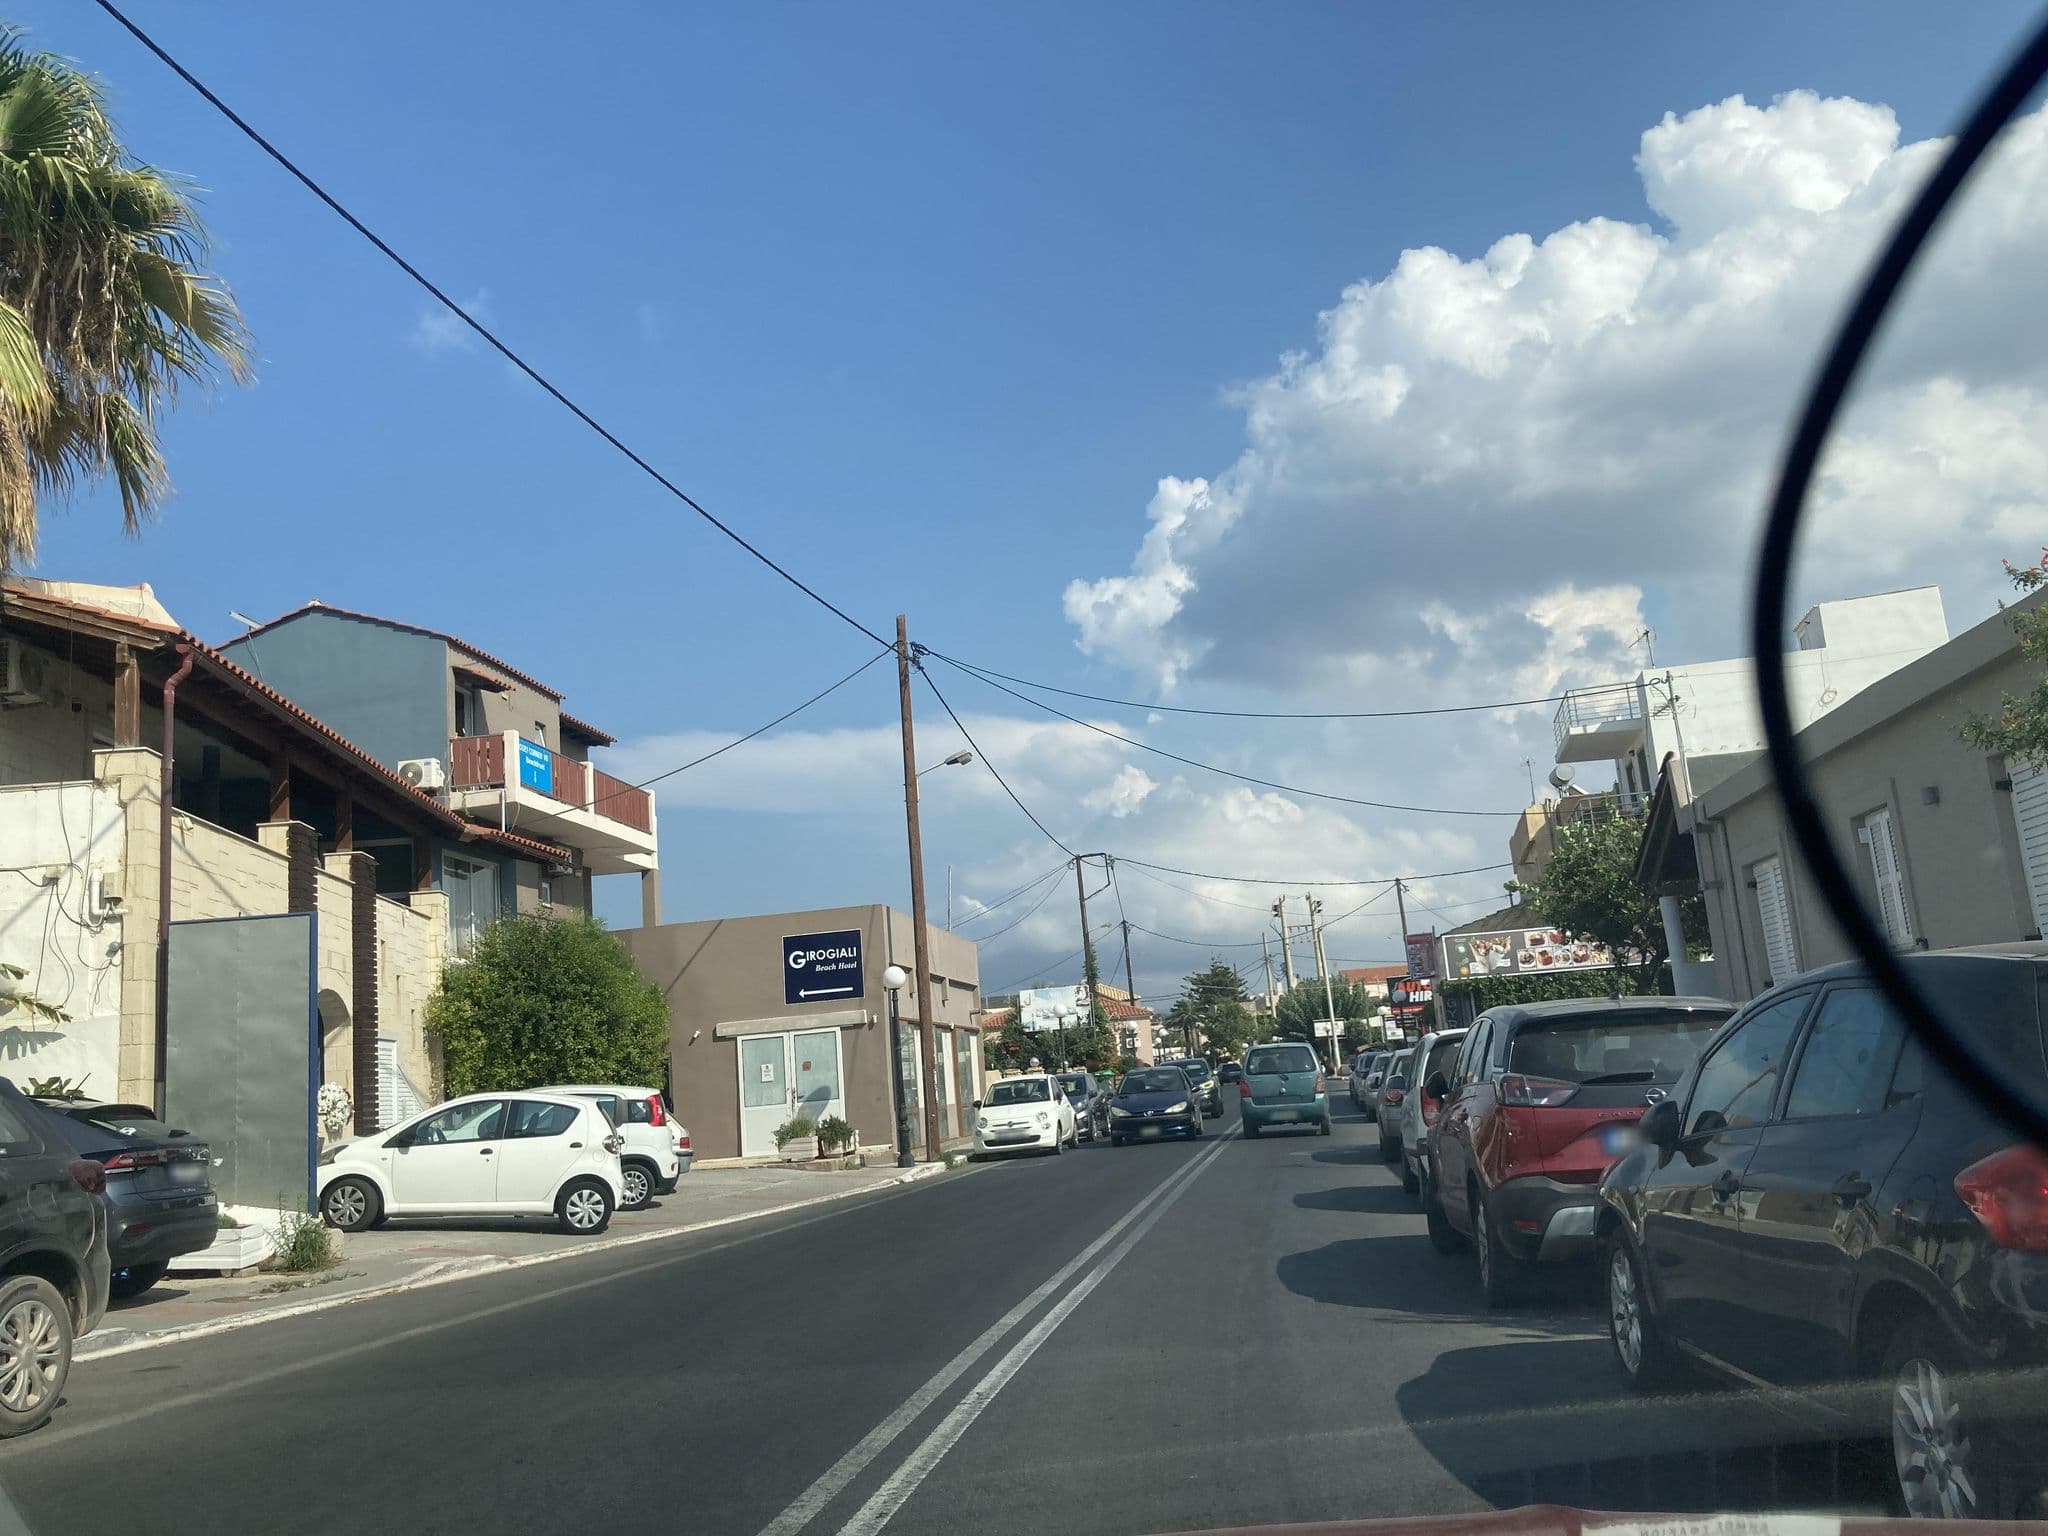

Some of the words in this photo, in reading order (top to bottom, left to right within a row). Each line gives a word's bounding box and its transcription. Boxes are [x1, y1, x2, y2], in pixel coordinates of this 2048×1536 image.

[789, 946, 857, 969] GIROGIALI
[815, 963, 837, 972] Beach
[838, 961, 857, 970] Hotel
[1409, 990, 1433, 1003] HIR
